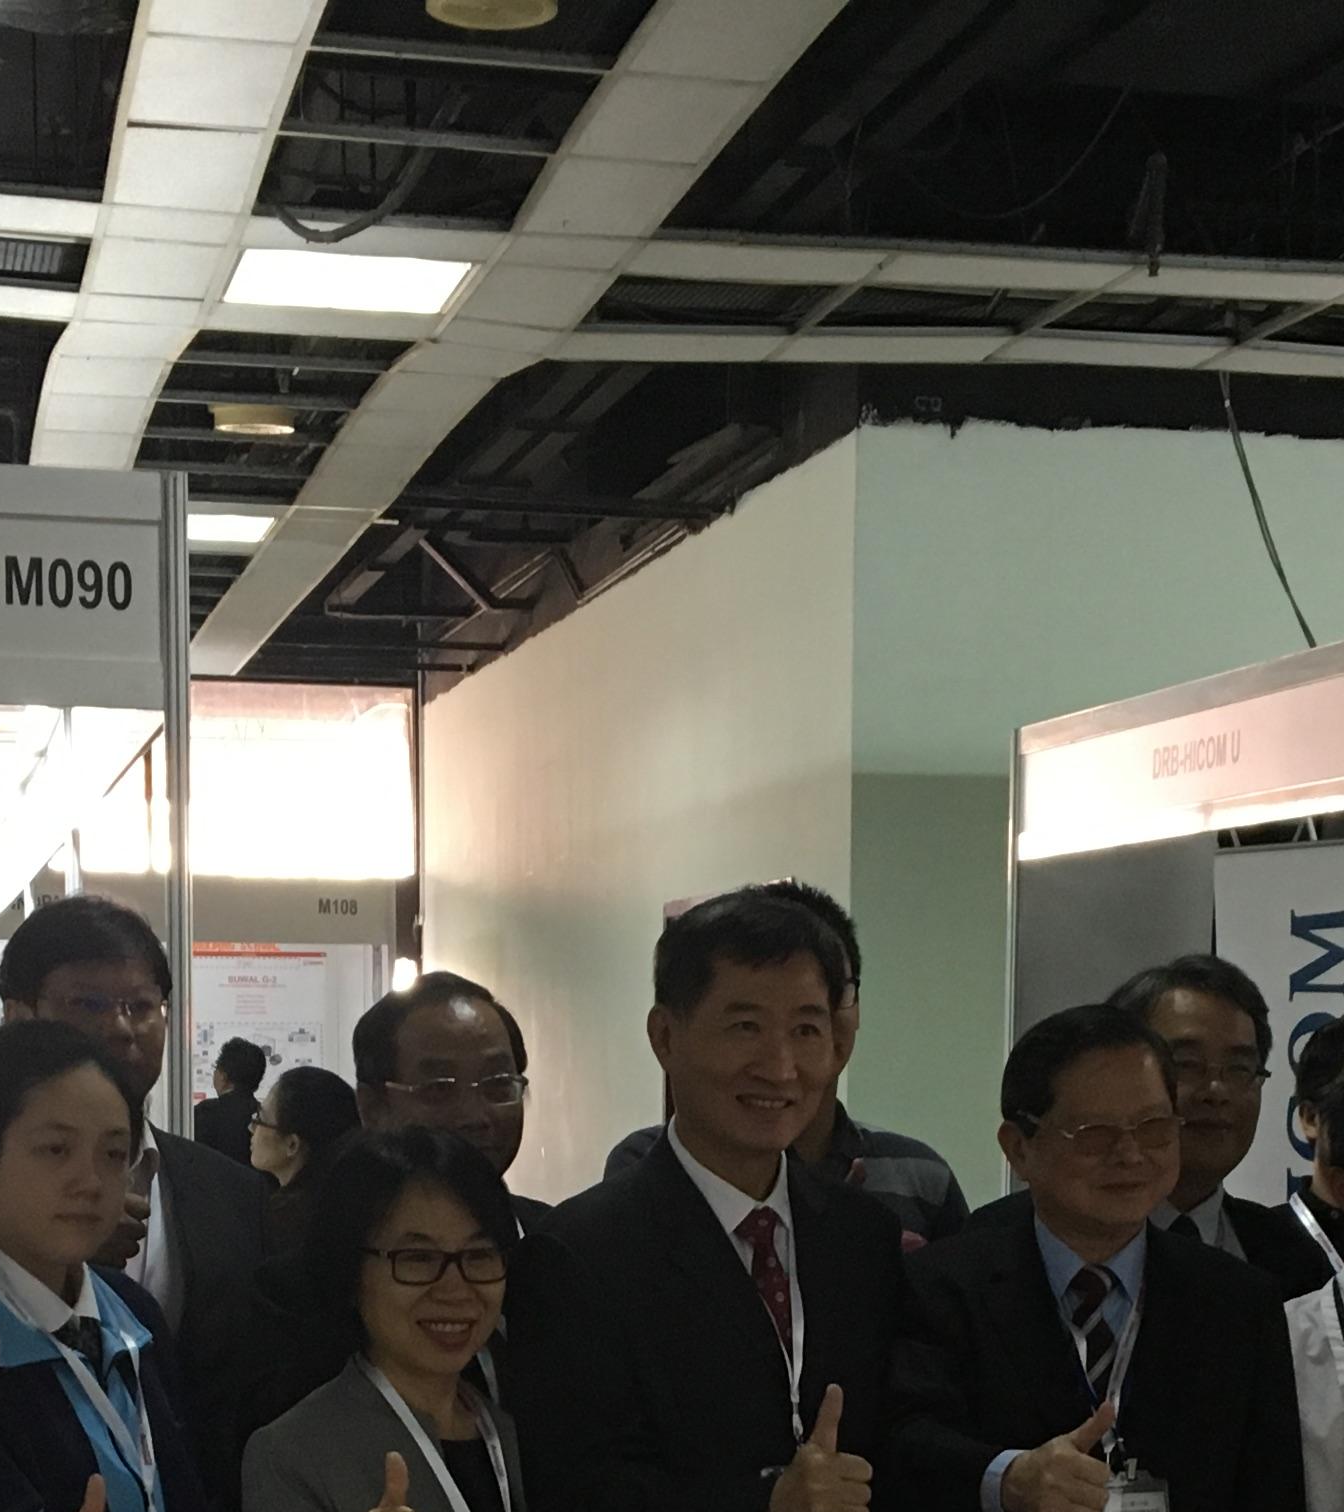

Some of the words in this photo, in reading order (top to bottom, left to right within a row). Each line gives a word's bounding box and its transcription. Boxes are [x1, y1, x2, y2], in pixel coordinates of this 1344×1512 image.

[4, 555, 133, 611] M090
[1151, 731, 1227, 781] DRB-HICOM
[1230, 729, 1241, 765] U
[318, 898, 358, 916] M108
